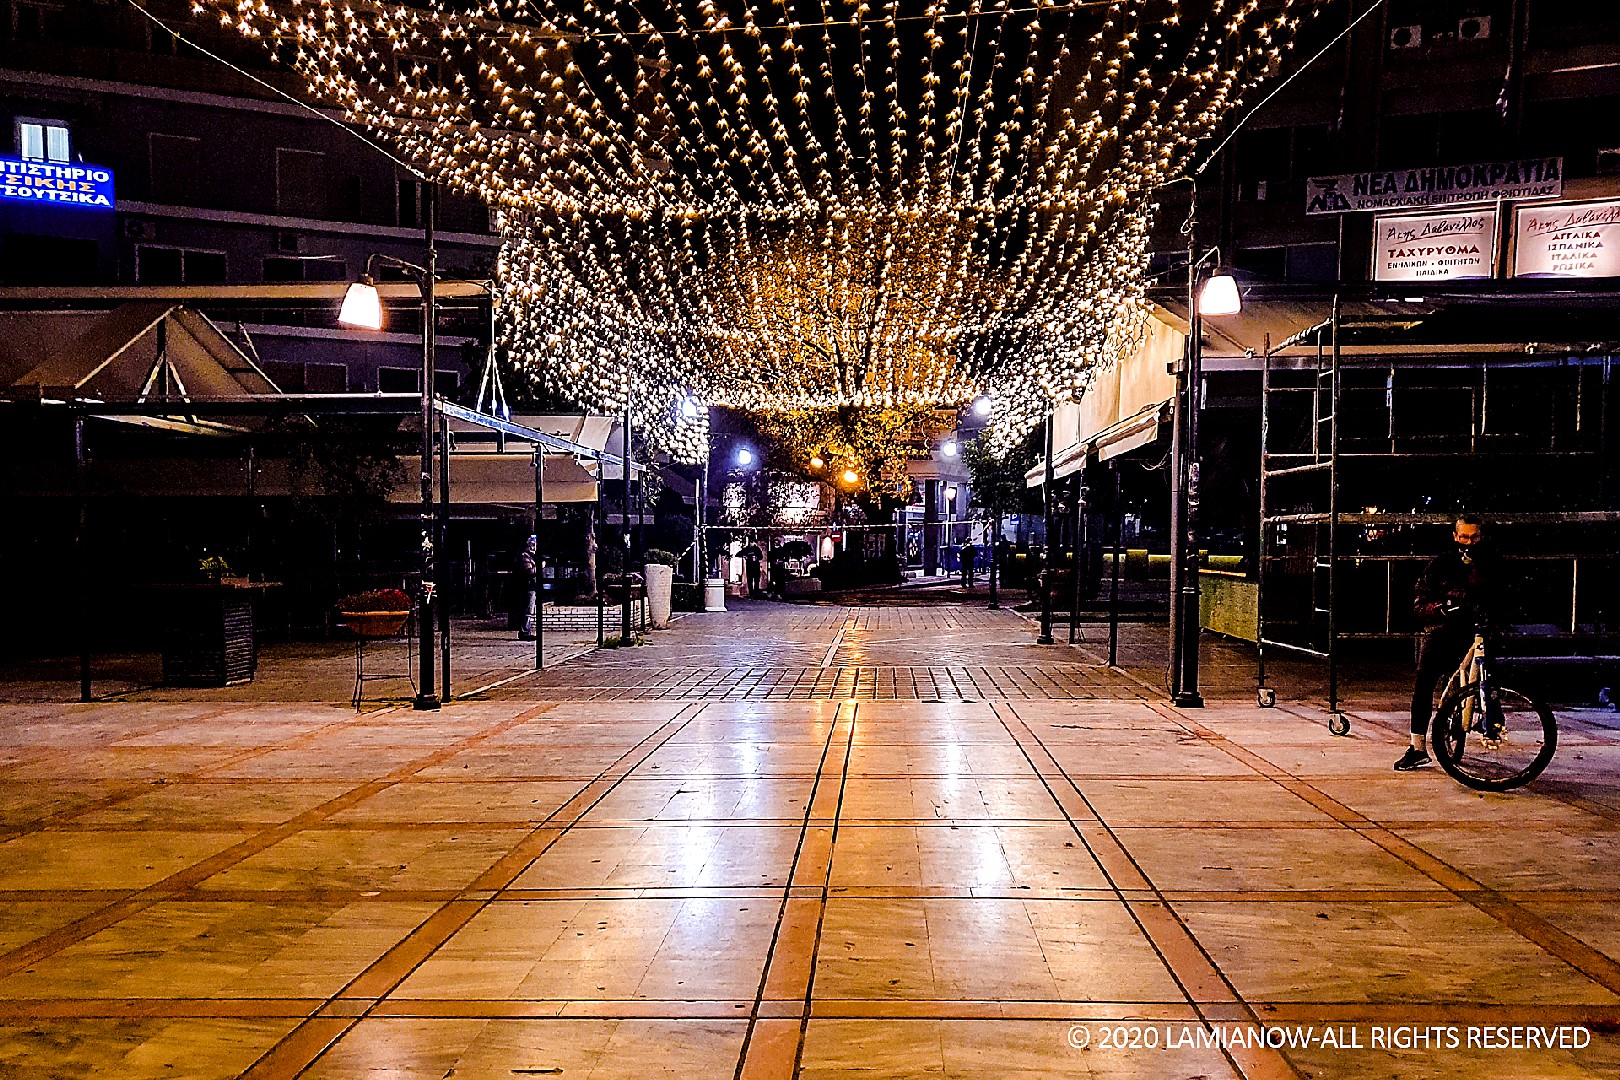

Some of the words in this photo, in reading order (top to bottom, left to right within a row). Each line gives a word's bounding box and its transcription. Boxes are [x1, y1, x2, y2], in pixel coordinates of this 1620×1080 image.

[0, 172, 96, 192] ΣΙΚΗΣ
[1353, 172, 1398, 196] ΝΕΑ
[1404, 160, 1559, 191] ΔΗΜΟΚΡΑΤΙΑ
[1357, 194, 1429, 209] ΝΟΜΑΡΧΙΑΚΗ
[1431, 189, 1488, 204] ΕΠΙΤΡΟΠΗ
[1551, 231, 1601, 241] ΑΓΓΛΙΚΑ
[1388, 244, 1480, 259] ΤΑΧΥΡΥΘΜΑ
[1548, 241, 1604, 251] ΙΣΠΑΝΙΚΑ
[1551, 252, 1598, 261] ΙΤΑΛΙΚΑ
[1552, 262, 1595, 272] ΡΩΣΙΚΑ
